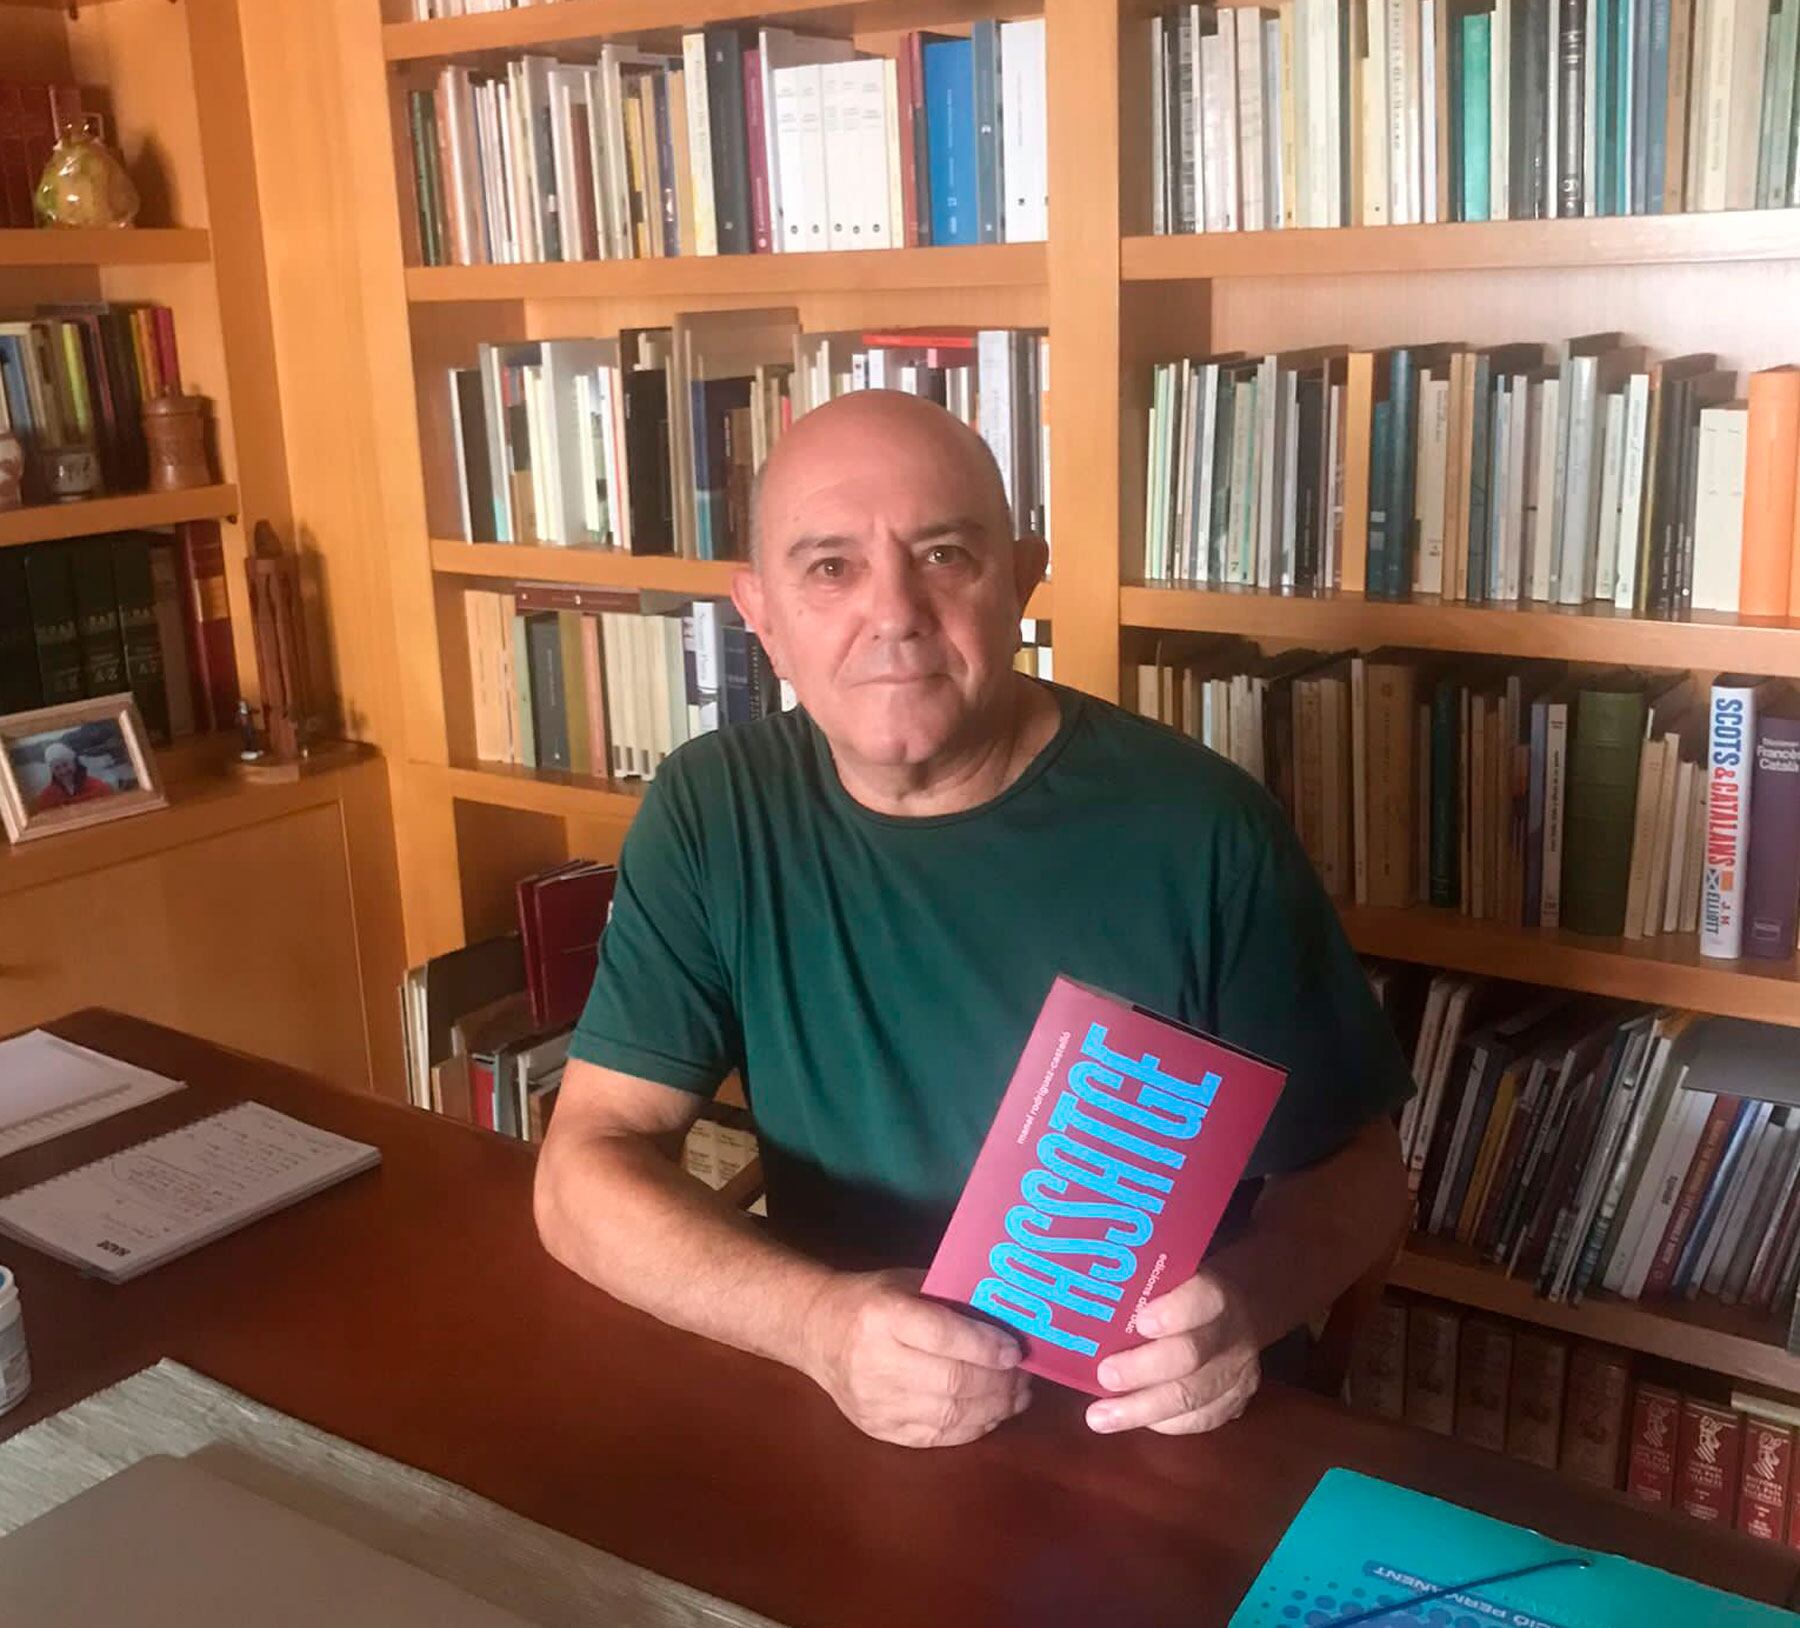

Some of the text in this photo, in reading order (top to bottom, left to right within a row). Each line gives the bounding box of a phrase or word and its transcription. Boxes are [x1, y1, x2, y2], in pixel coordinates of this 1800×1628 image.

[1707, 698, 1743, 867] SCOTS & CATALANS
[1705, 891, 1720, 935] ELLIOTT
[1017, 1113, 1035, 1145] manel
[969, 1021, 1224, 1358] PASSATGE
[1142, 1253, 1167, 1296] edicions
